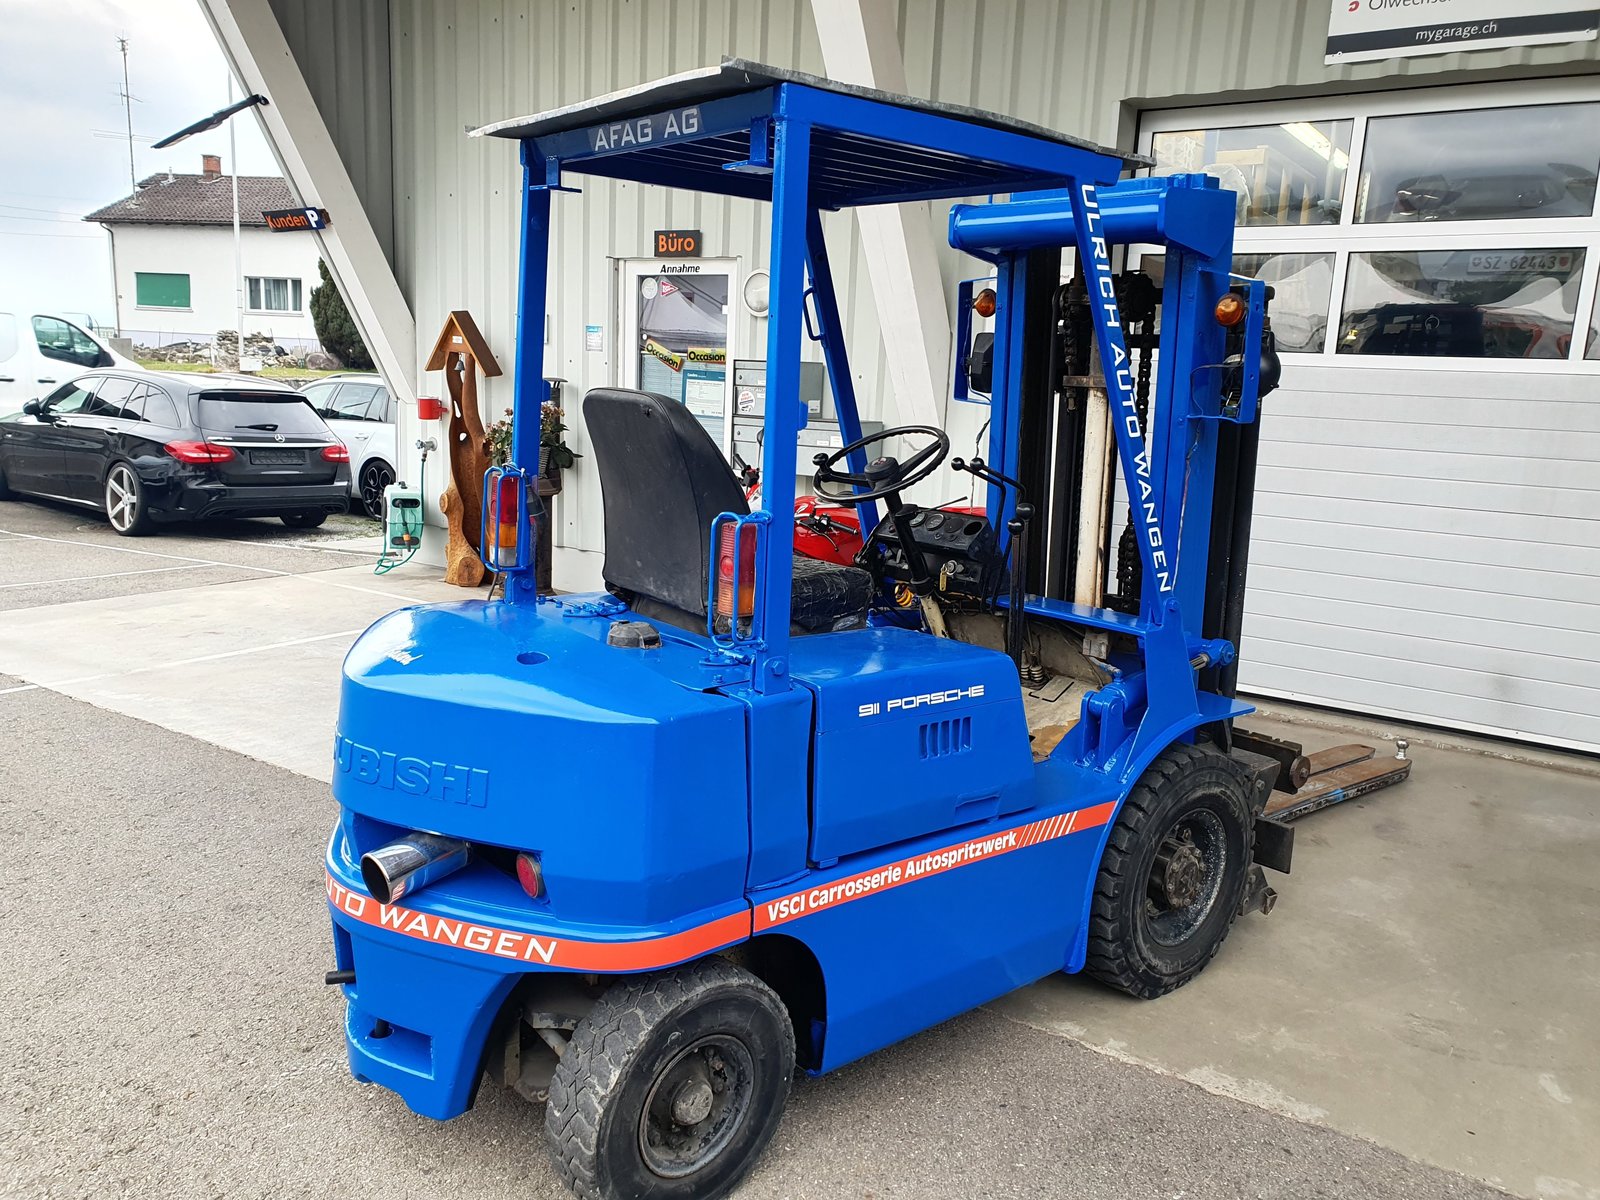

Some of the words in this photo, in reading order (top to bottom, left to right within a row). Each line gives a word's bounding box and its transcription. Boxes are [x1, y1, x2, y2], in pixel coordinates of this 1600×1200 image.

[1416, 22, 1497, 41] mygarage.ch
[595, 118, 652, 152] AFAG
[664, 108, 698, 139] AG
[265, 213, 308, 229] Kunden
[658, 233, 695, 252] Büro
[660, 263, 701, 273] Annahme
[646, 343, 679, 369] Occasion
[688, 351, 726, 361] Occasion
[1081, 184, 1120, 328] ULRICH
[1110, 342, 1139, 438] AUTO
[1133, 451, 1172, 593] WANGEN
[858, 702, 880, 717] 911
[887, 684, 985, 712] PORSCHE
[767, 896, 806, 922] VSCI
[808, 865, 902, 909] Carrosserie
[904, 831, 1017, 878] Autospritzwerk
[380, 904, 558, 964] WANGEN
